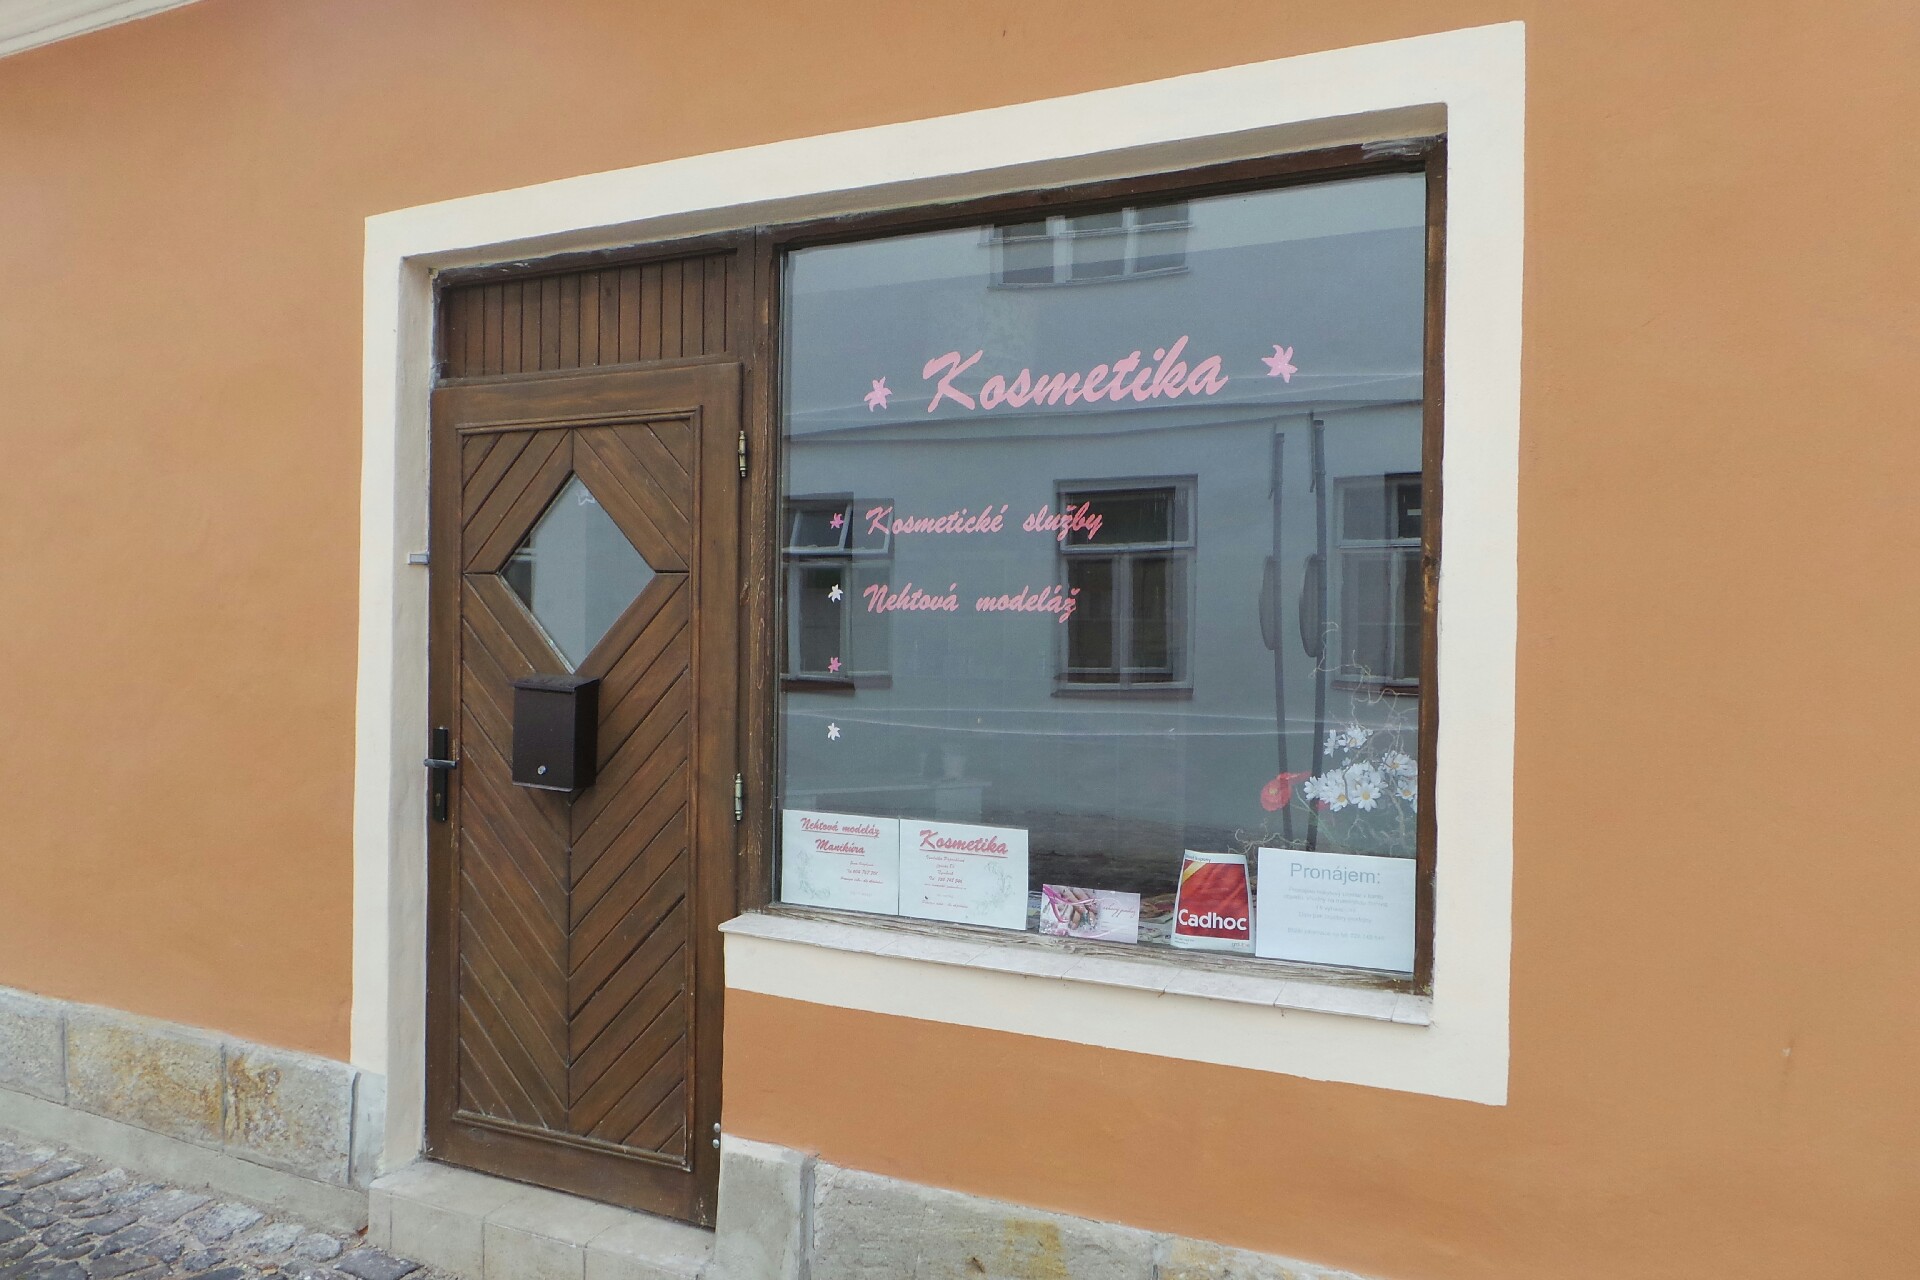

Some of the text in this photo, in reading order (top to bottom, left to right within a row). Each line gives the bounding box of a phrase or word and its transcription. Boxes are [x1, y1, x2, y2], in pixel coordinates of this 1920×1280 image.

[923, 336, 1228, 411] Kosmetika
[866, 501, 1103, 541] Kosmetické služby
[864, 583, 1081, 623] Nehtová modeláž
[800, 817, 839, 832] Nehtová
[814, 839, 866, 853] Manikúra
[919, 829, 1008, 855] Kosmetika
[1290, 862, 1381, 885] Pronájem:
[1178, 908, 1247, 931] Cadhoc
